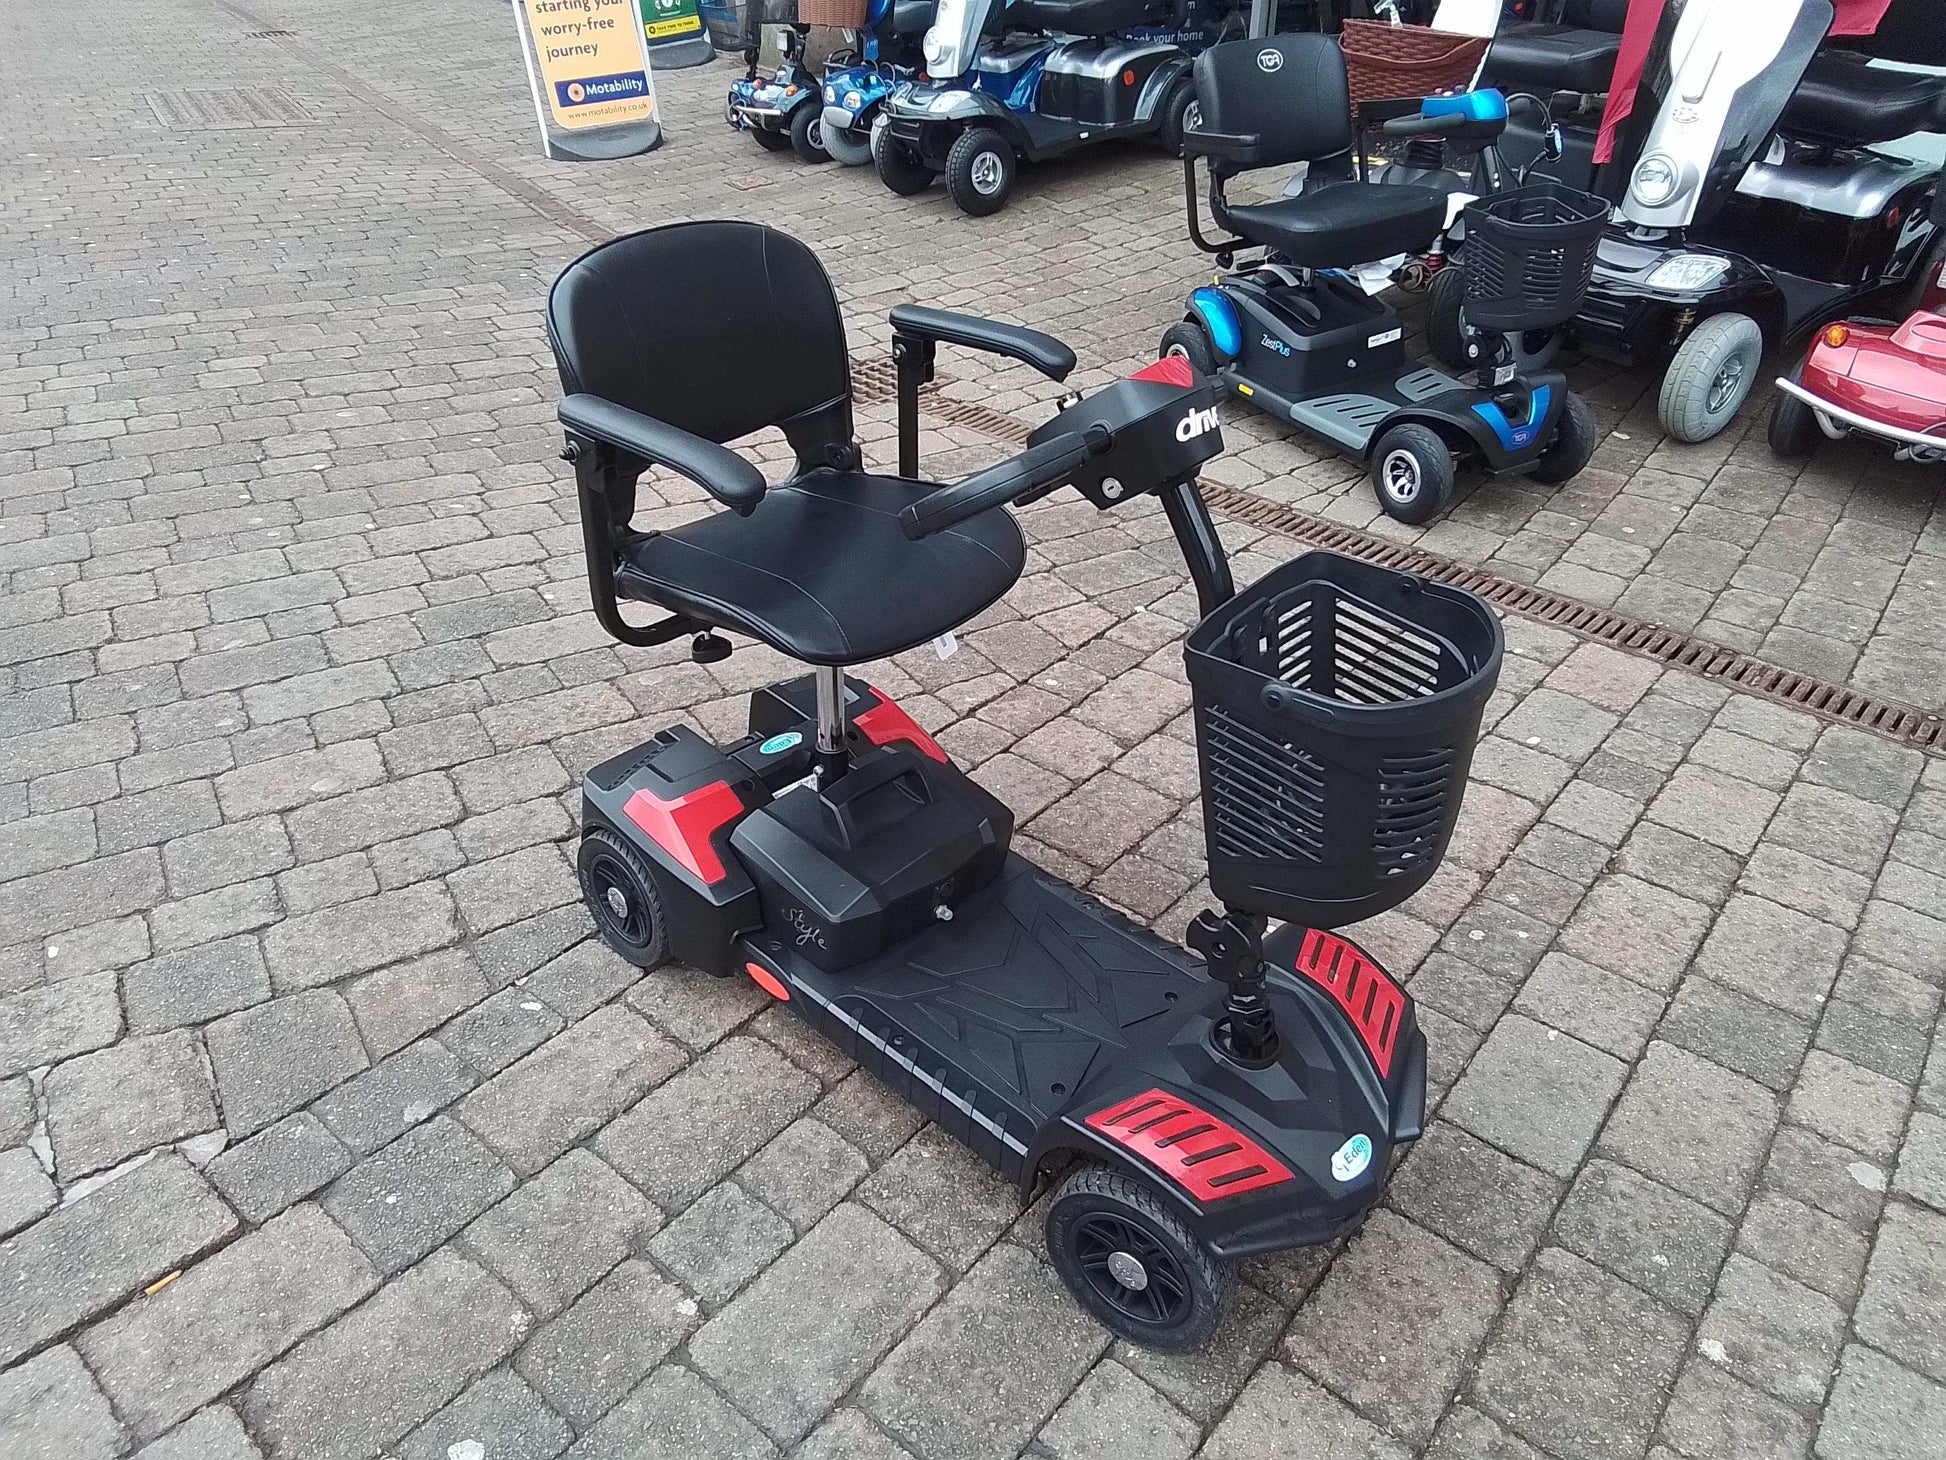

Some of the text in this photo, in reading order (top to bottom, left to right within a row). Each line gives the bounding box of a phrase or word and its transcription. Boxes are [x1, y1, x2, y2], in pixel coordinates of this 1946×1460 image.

[535, 0, 591, 14] starting
[540, 17, 615, 36] worry-free
[1153, 33, 1175, 45] your
[1177, 30, 1204, 42] home
[545, 43, 599, 63] journey
[1260, 53, 1281, 68] TGA
[585, 78, 643, 96] Motability
[567, 100, 648, 119] www.motability.co.uk
[1260, 333, 1291, 358] ZestPlus
[1175, 405, 1220, 442] driv
[781, 908, 828, 950] Style
[1343, 1140, 1366, 1165] Eden
